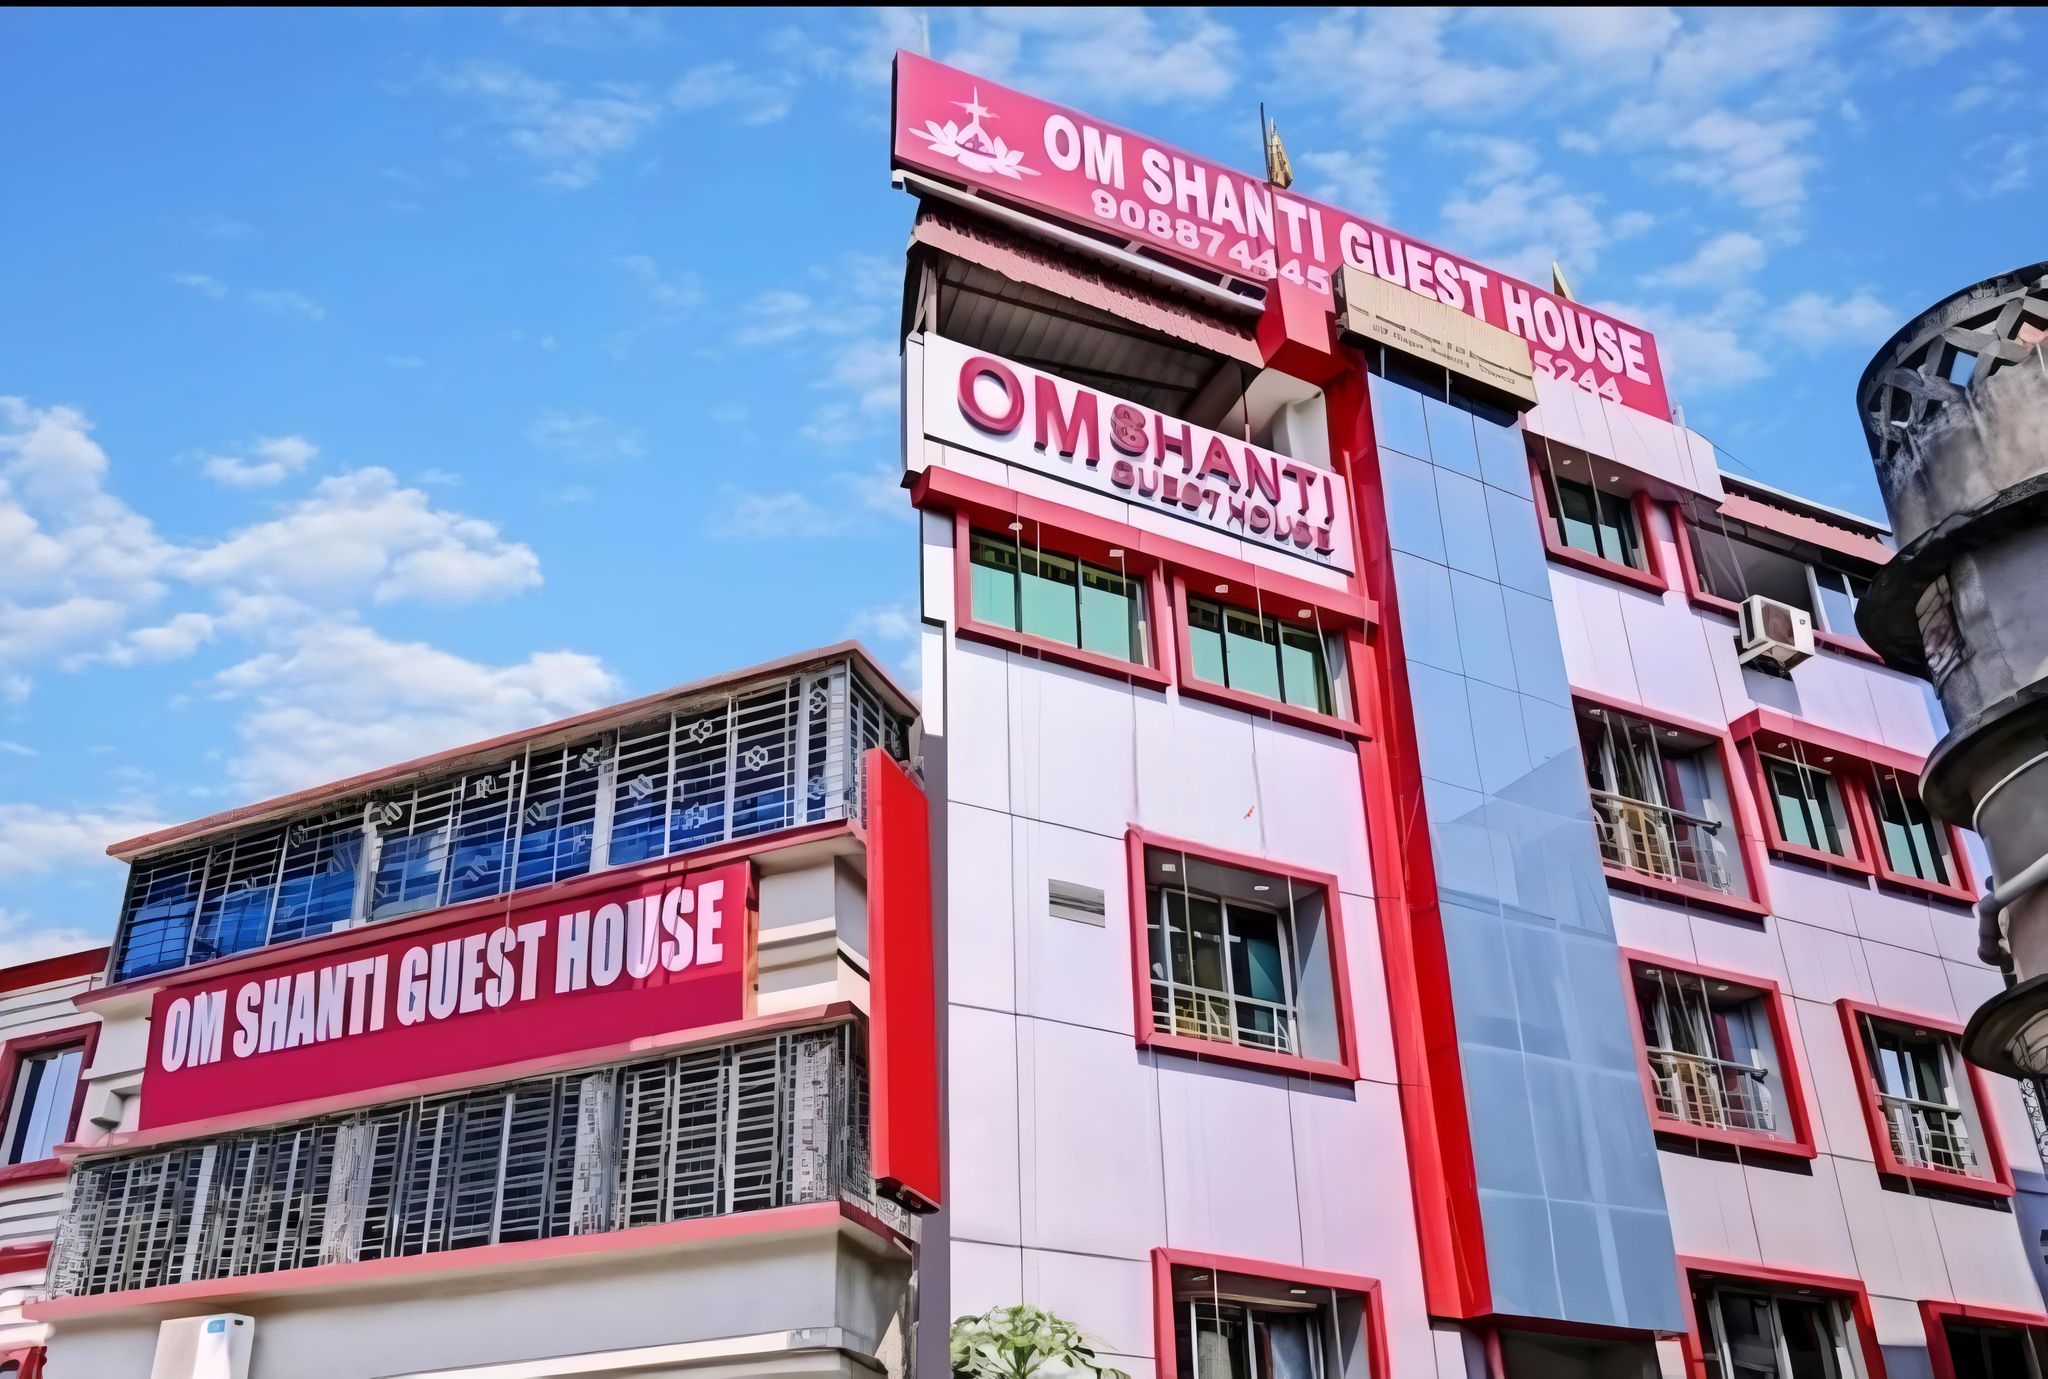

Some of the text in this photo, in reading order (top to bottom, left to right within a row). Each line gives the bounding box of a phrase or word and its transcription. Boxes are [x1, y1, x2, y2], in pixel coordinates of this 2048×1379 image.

[1043, 114, 1125, 190] OM
[1141, 148, 1325, 263] SHANTI
[1339, 221, 1488, 322] GUEST
[1501, 281, 1652, 386] HOUSE
[957, 356, 1334, 525] OM SHANTI
[161, 880, 725, 1073] OM SHANTI GUEST HOUSE
